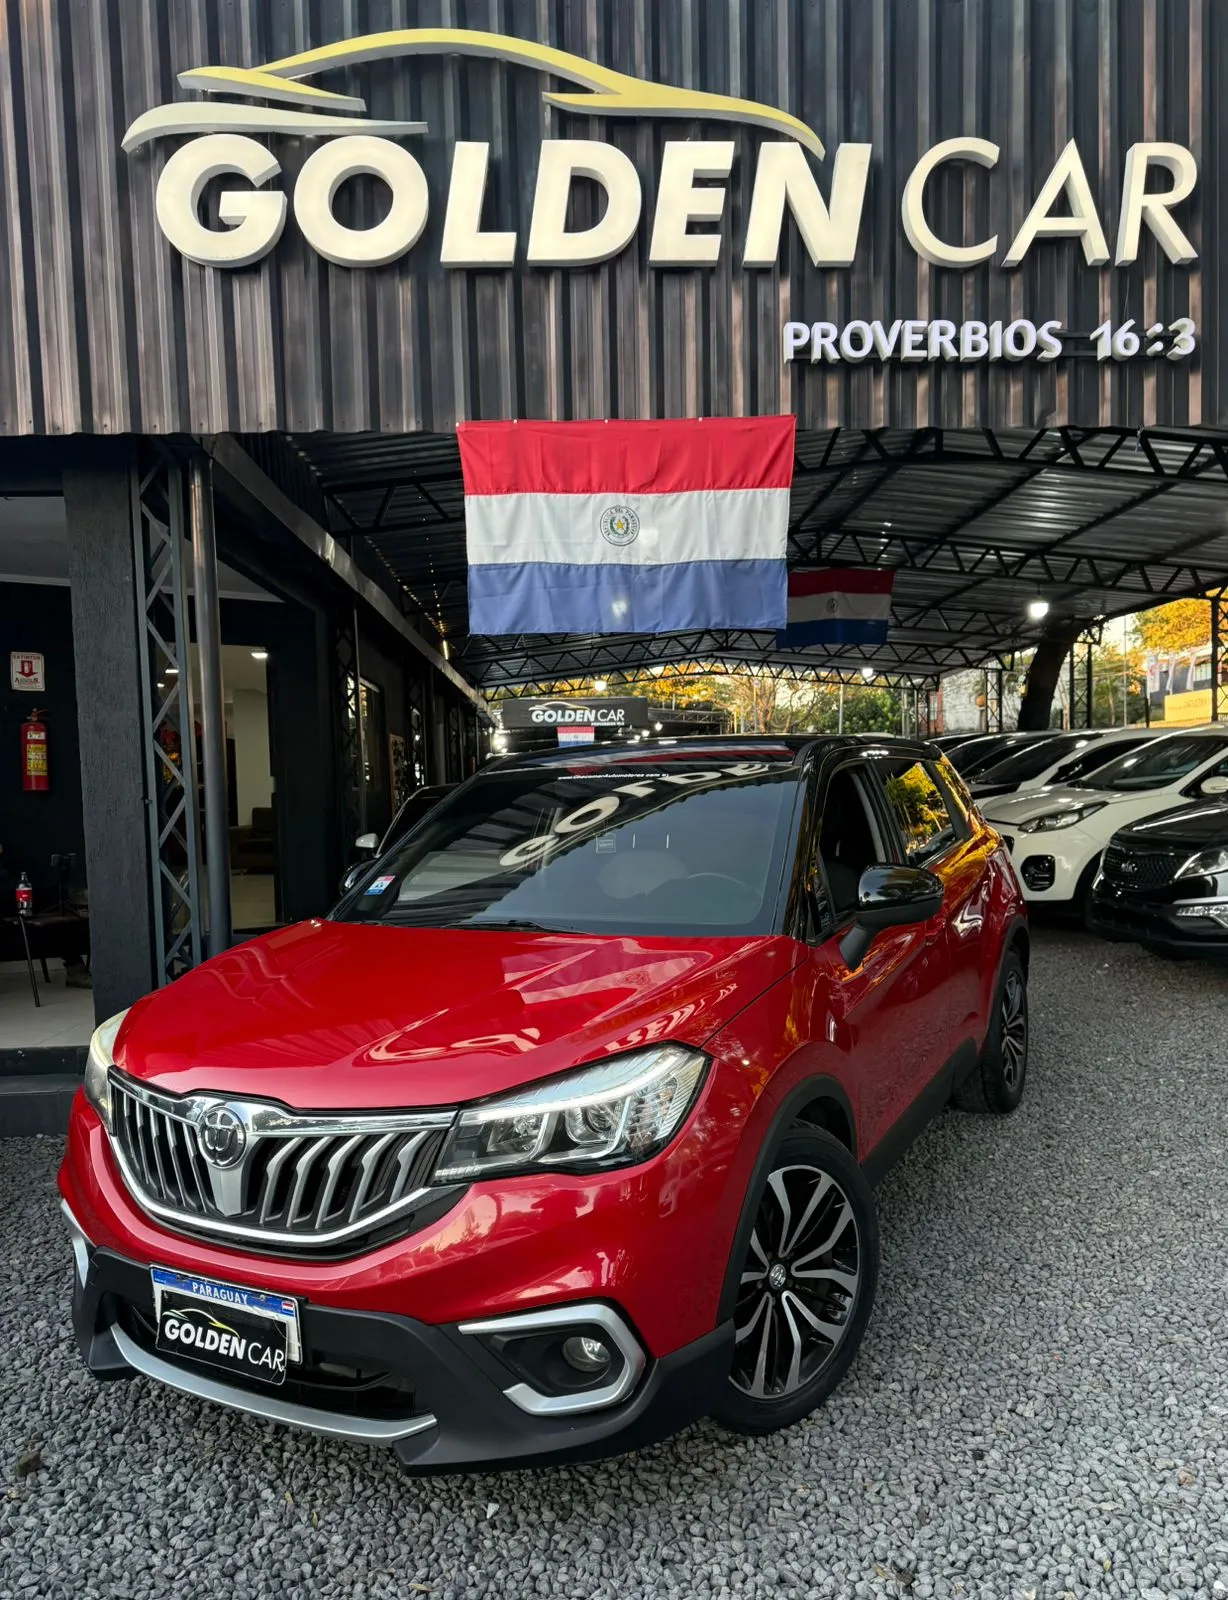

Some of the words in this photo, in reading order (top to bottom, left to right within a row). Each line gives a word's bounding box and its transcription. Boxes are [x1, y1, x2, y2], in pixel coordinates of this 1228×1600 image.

[156, 133, 872, 269] GOLDEN
[901, 136, 1199, 269] CAR
[784, 318, 1064, 364] PROVERBIOS
[1089, 317, 1197, 362] 16:3
[531, 709, 596, 723] GOLDEN
[597, 709, 625, 722] CAR
[192, 1281, 249, 1305] PARAGUAY
[164, 1318, 247, 1360] GOLDEN
[247, 1341, 285, 1372] CAR
